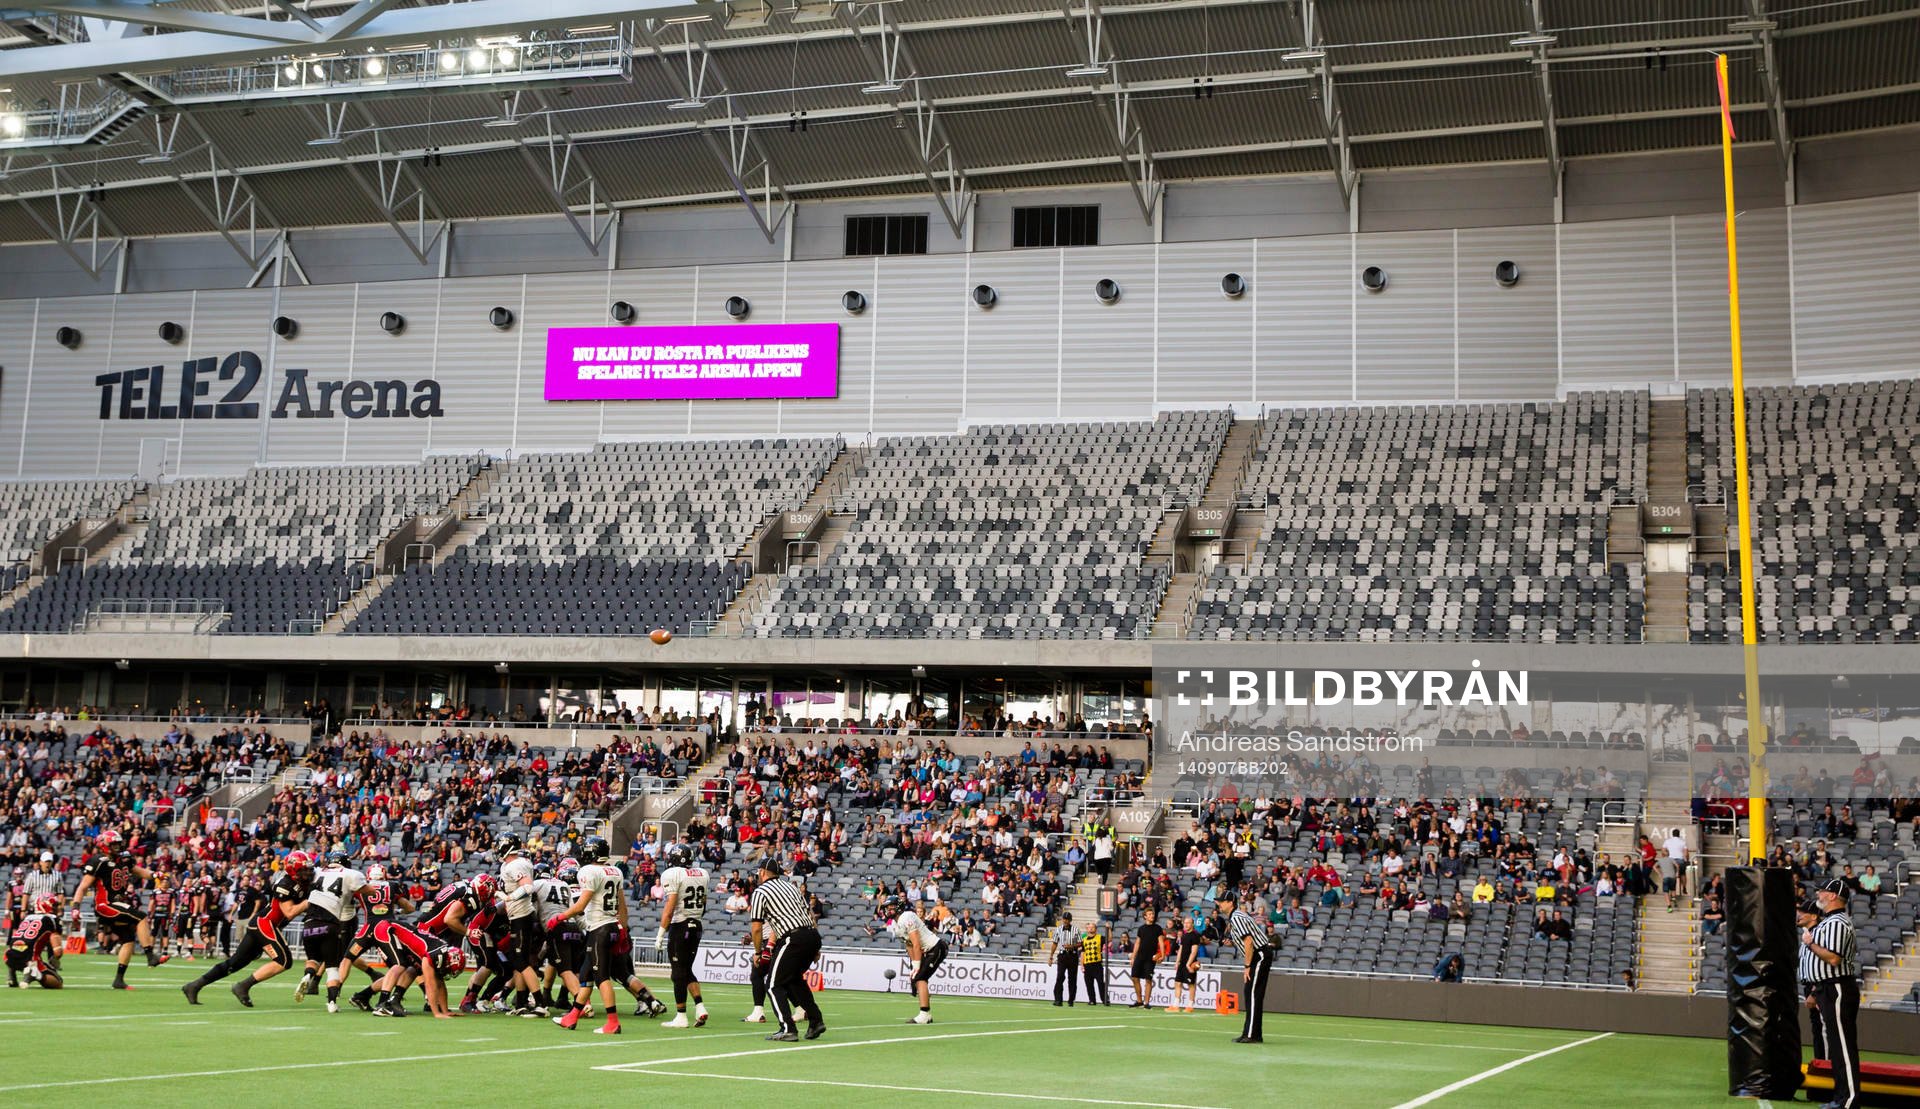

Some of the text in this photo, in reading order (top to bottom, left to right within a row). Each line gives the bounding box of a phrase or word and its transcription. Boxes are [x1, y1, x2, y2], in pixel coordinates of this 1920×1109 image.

[573, 344, 809, 361] NU KAN DU RÖSTA PÅ PUBLIKENS
[578, 363, 802, 379] SPELARE I TELE2 ARENA APPEN
[95, 350, 444, 419] TELE2 Arena
[1197, 510, 1222, 520] B305
[1652, 506, 1681, 516] B304
[1119, 810, 1150, 822] A105
[367, 885, 391, 904] 51
[12, 920, 42, 939] 28
[303, 926, 329, 937] FLEX
[66, 937, 81, 951] 30
[704, 970, 721, 981] The
[935, 961, 1047, 984] Stockholm
[963, 984, 975, 993] of
[978, 984, 1046, 997] Scandinavia
[1108, 991, 1127, 1001] The
